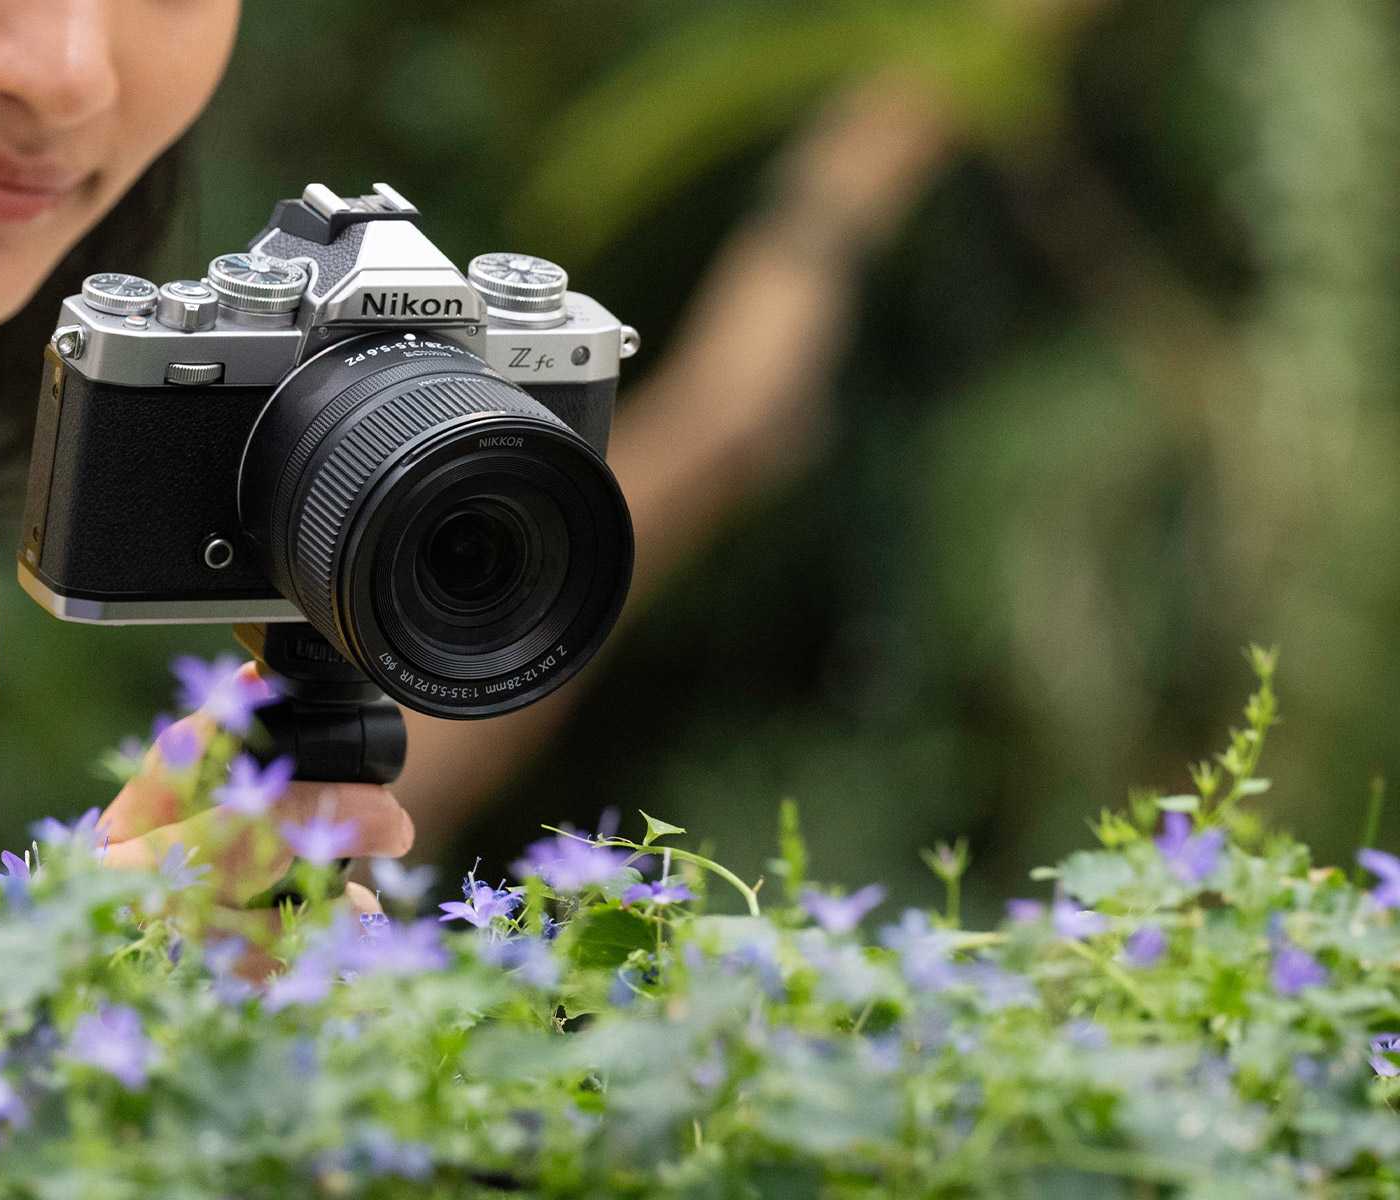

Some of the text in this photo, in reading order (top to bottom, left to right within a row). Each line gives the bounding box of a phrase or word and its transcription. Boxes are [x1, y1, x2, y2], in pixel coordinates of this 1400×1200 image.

[361, 292, 463, 316] Nikon
[344, 353, 366, 366] PZ
[533, 353, 555, 372] fc
[418, 377, 452, 386] ZOOM
[479, 436, 524, 448] NIKKOR
[557, 645, 567, 657] Z
[538, 655, 556, 672] DX
[399, 669, 414, 683] VR
[485, 671, 538, 694] 12-28mm
[413, 678, 430, 692] PZ
[430, 684, 479, 699] 1:3.5-5.6
